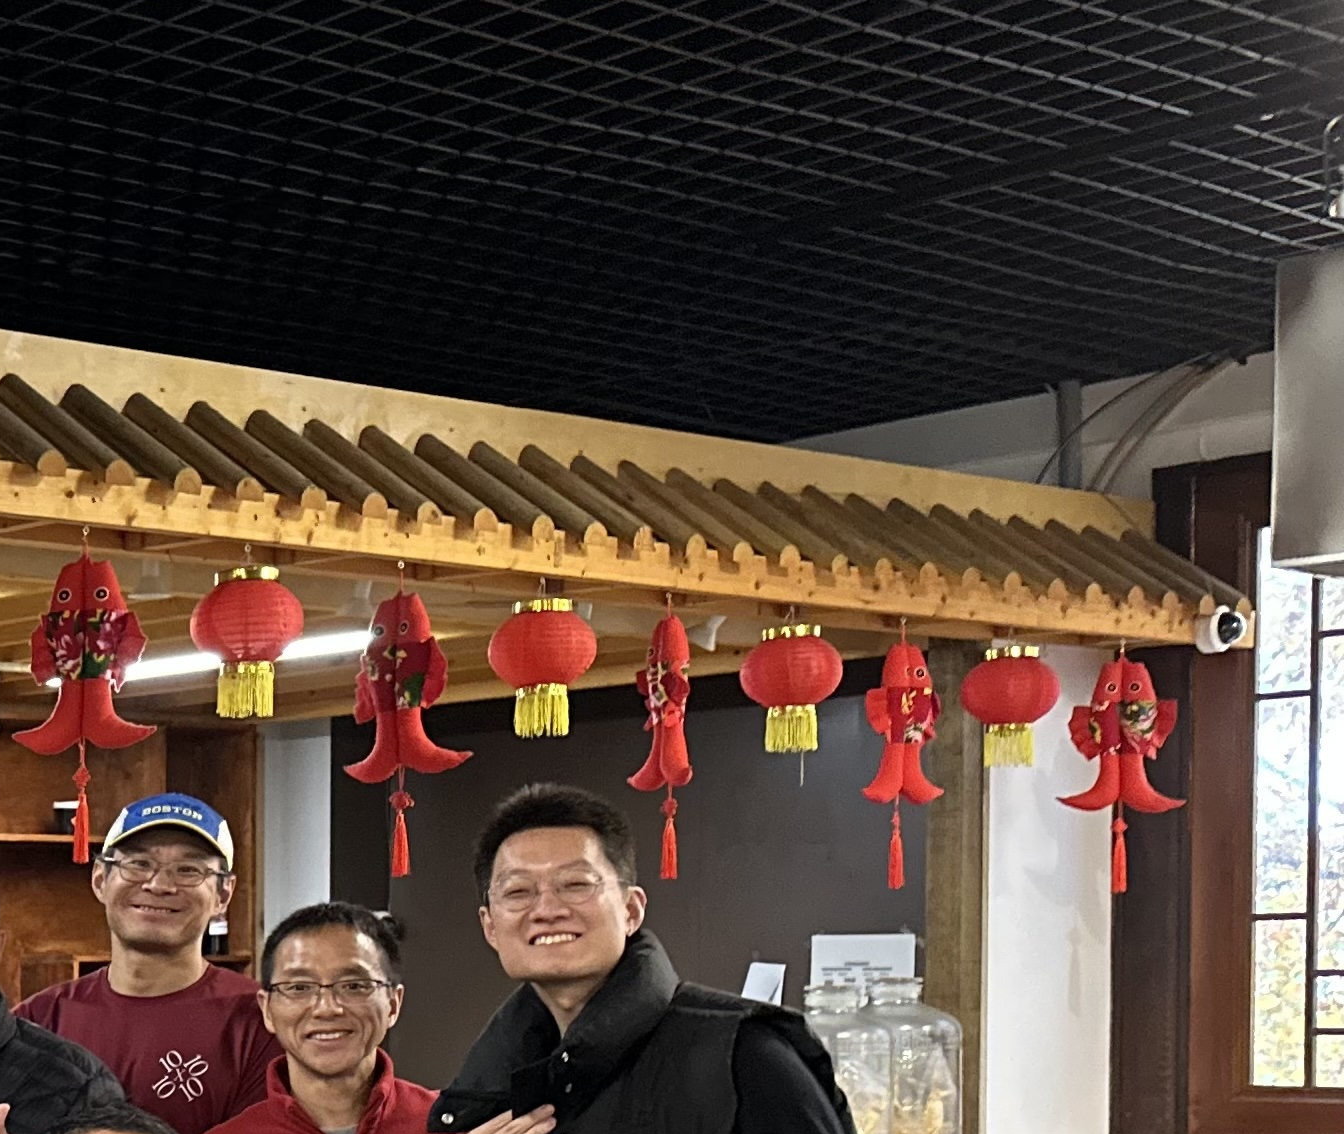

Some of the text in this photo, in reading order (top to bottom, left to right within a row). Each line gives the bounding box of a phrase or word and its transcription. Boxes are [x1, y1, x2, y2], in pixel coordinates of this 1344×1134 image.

[142, 804, 202, 820] BOSTON
[159, 1050, 209, 1077] 10 10
[152, 1076, 204, 1102] 10 10
